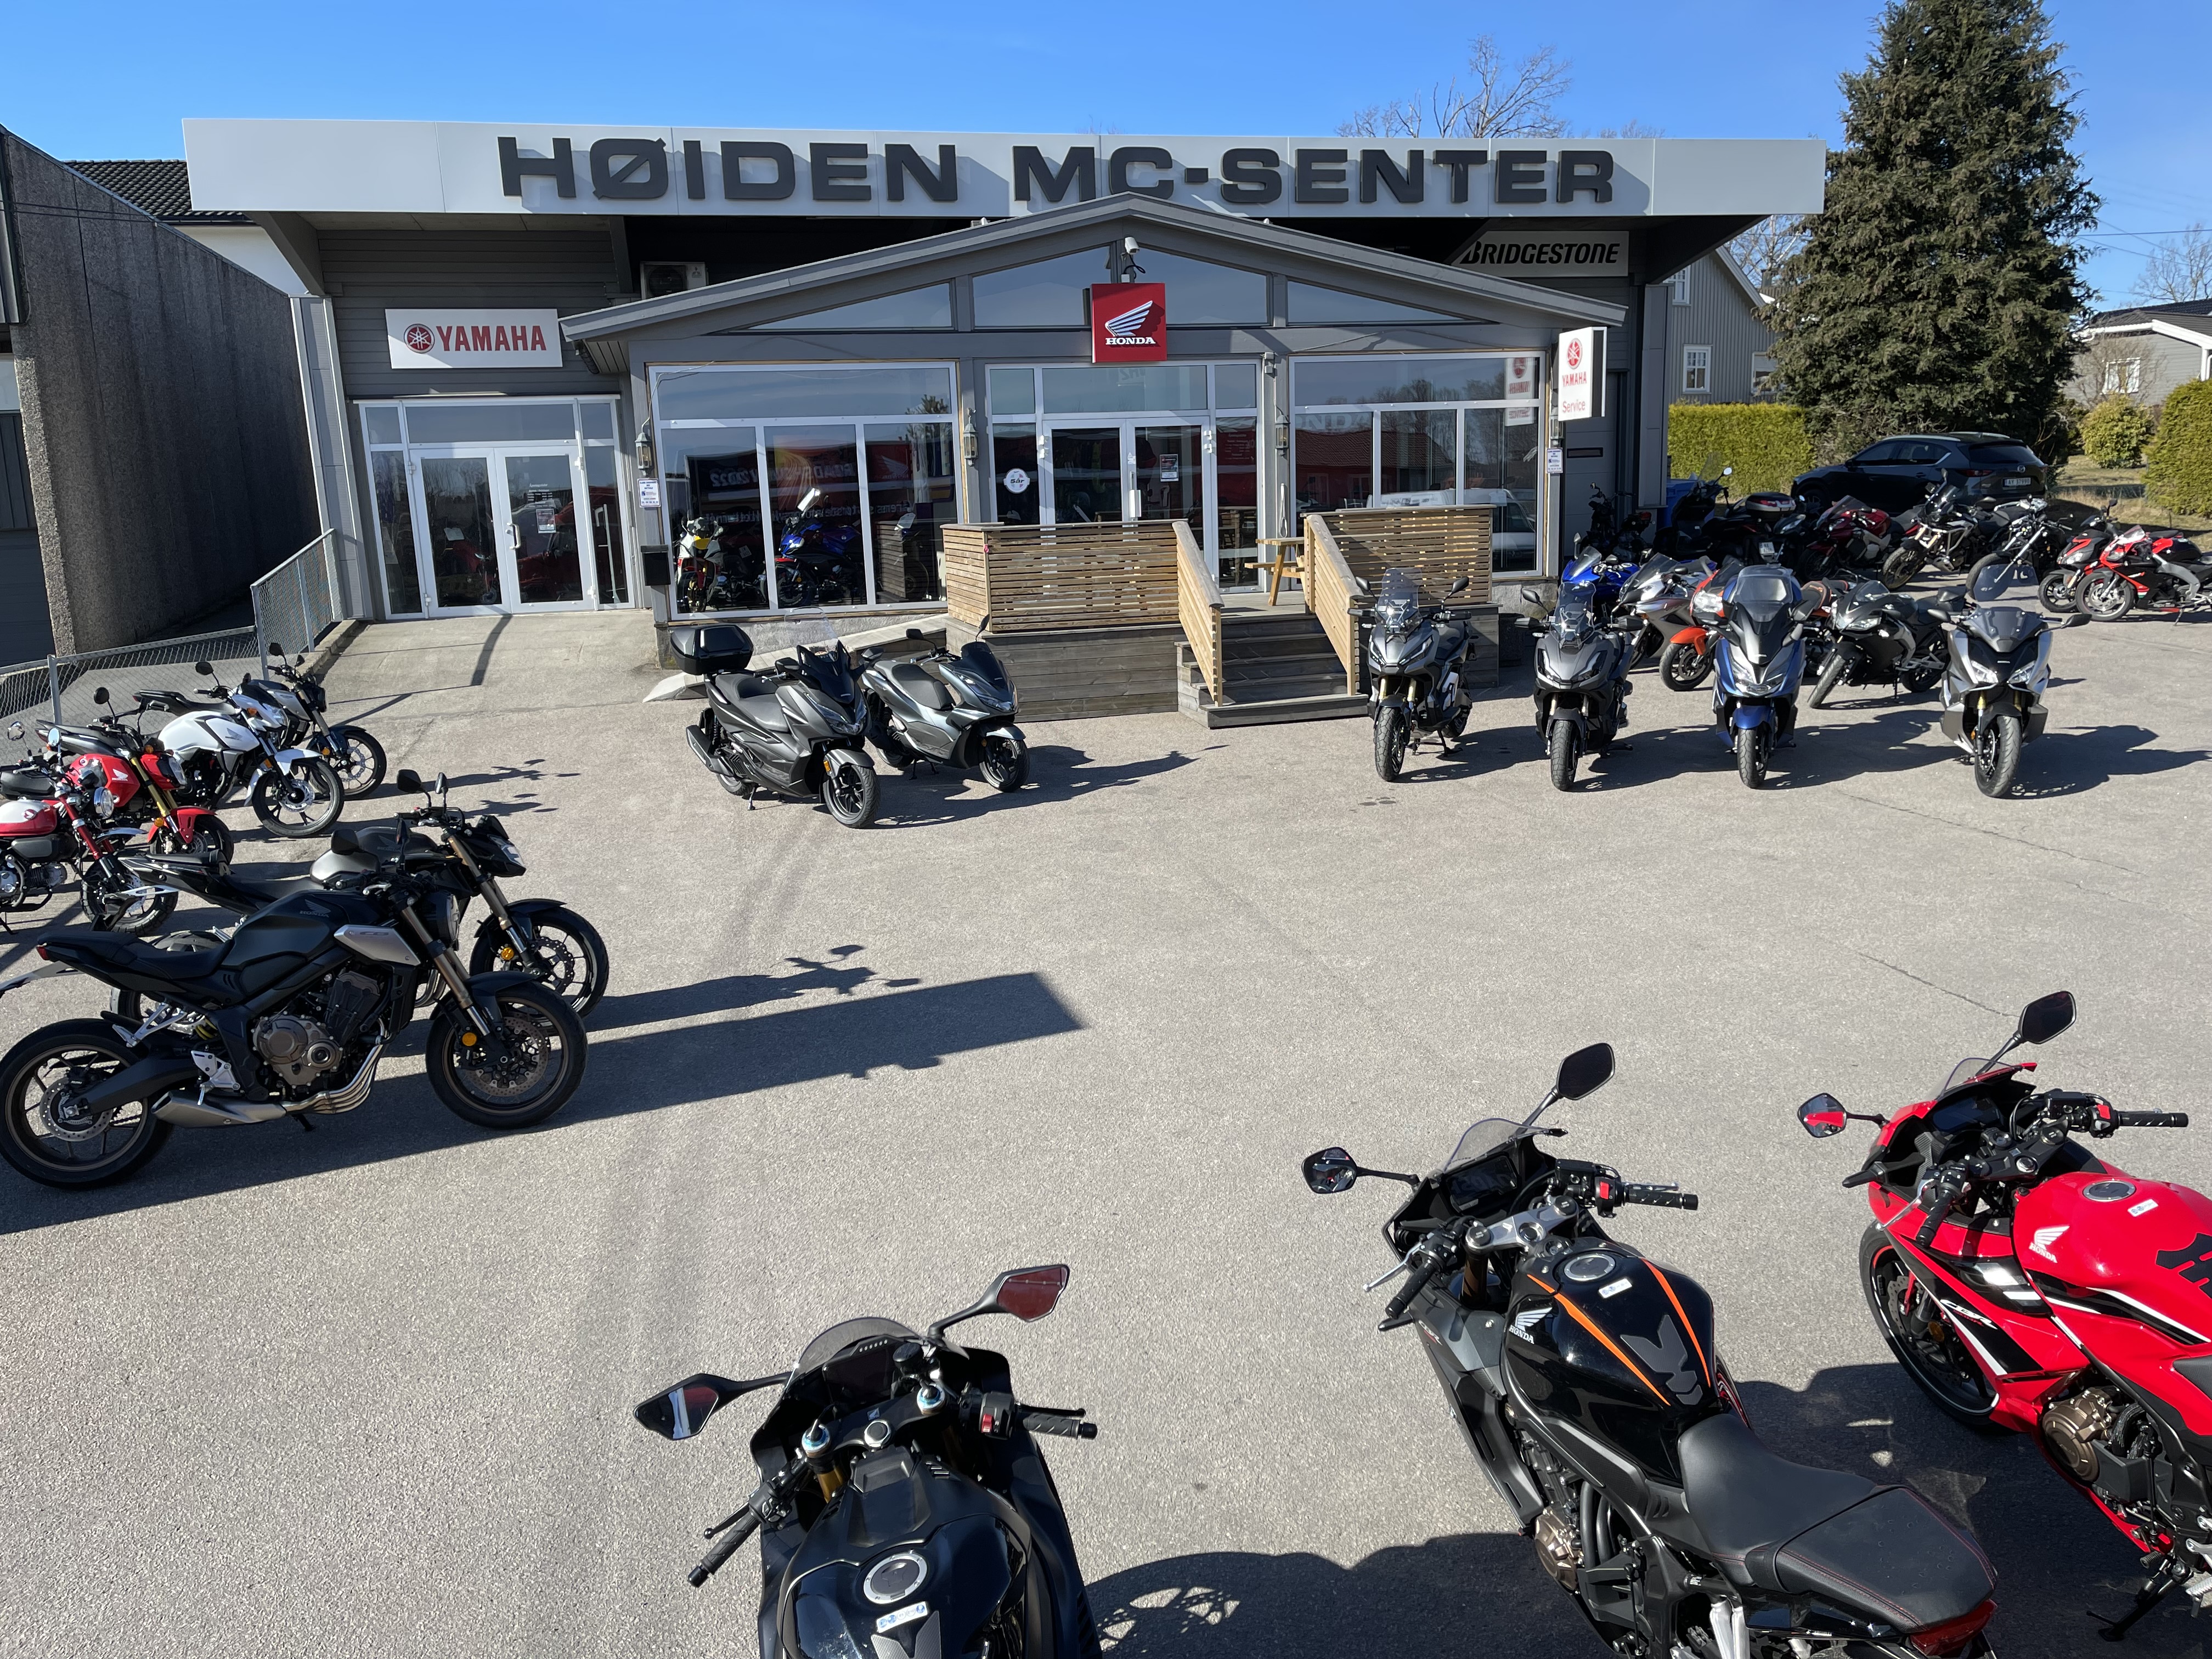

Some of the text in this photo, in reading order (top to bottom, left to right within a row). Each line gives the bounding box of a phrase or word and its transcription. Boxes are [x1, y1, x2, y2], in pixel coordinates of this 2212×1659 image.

[498, 136, 1614, 204] HØIDEN MC-SENTER
[1459, 240, 1620, 264] BRIDGESTONE
[436, 325, 547, 352] YAMAHA
[1105, 336, 1156, 345] HONDA
[1562, 371, 1587, 387] YAMAHA
[1562, 399, 1585, 413] Service
[2028, 1242, 2058, 1263] HONDA
[1509, 1324, 1534, 1345] HONDA
